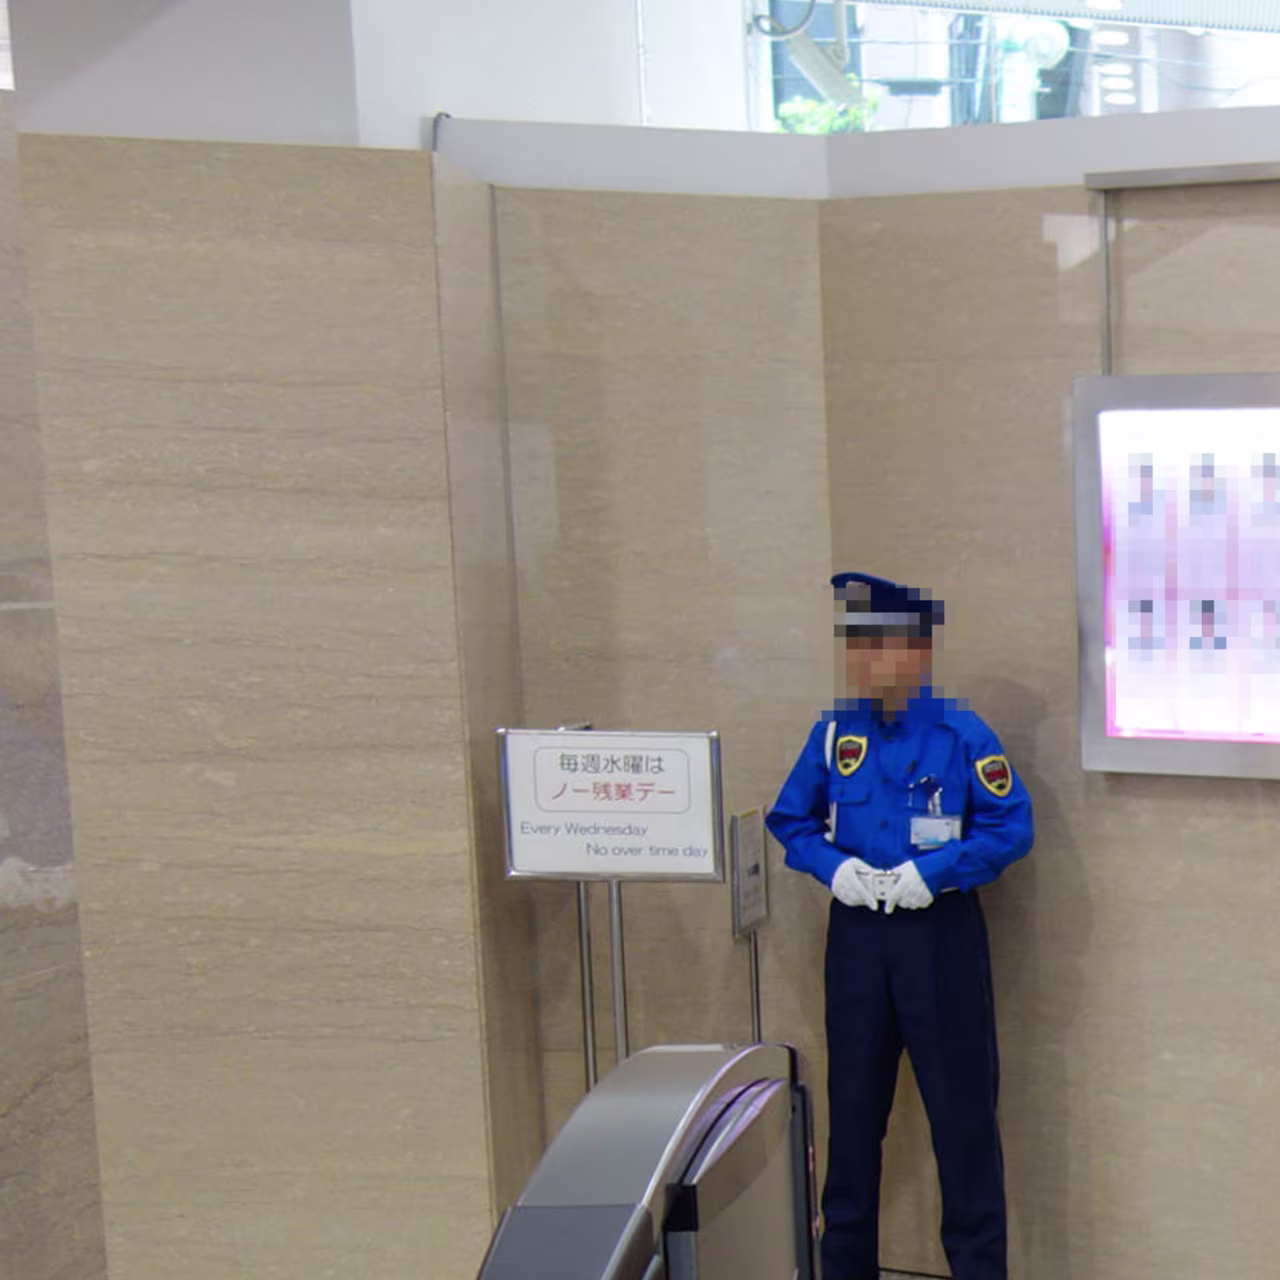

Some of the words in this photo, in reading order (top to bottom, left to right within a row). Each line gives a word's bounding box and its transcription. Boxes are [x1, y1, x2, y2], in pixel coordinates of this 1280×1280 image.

[559, 754, 664, 774] 毎週水曜は
[552, 782, 675, 801] ノー残業デー
[521, 821, 561, 836] Every
[565, 822, 648, 836] Wednesday
[586, 843, 609, 857] No
[611, 846, 643, 857] over
[649, 845, 680, 858] time
[682, 845, 708, 858] day
